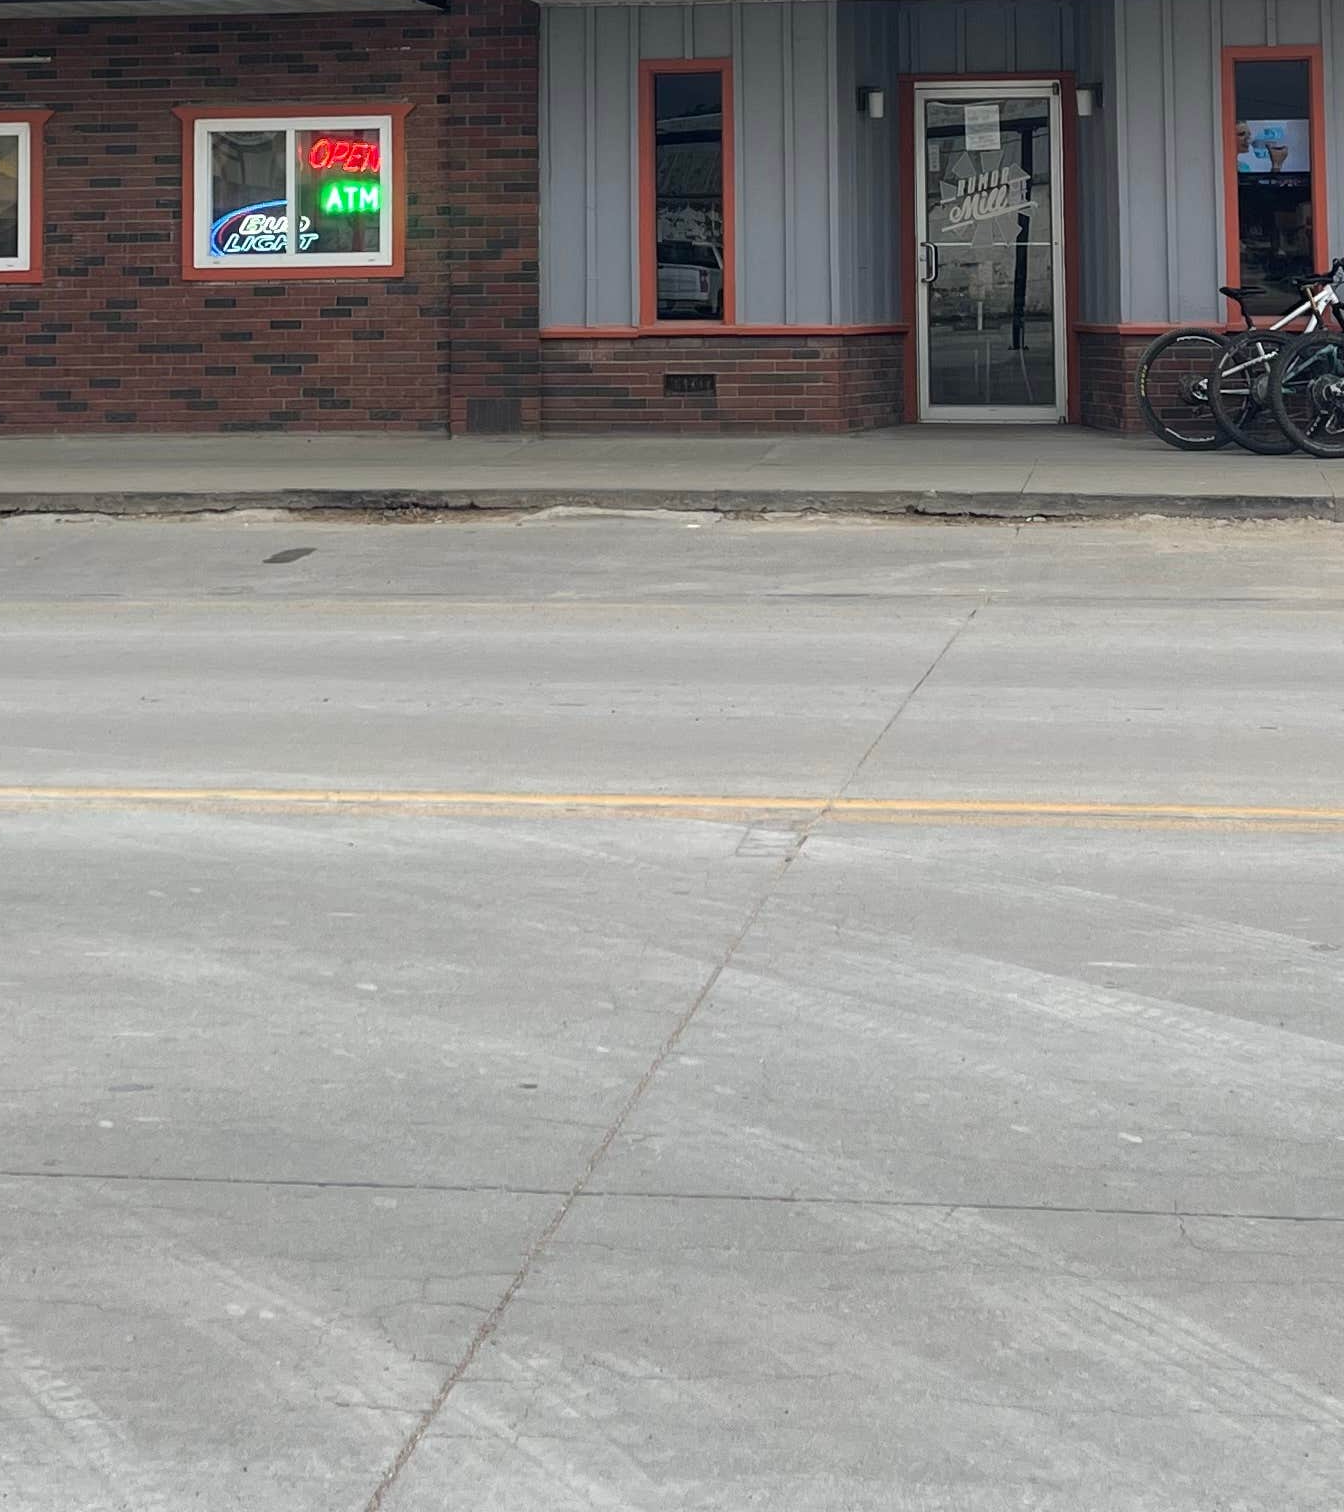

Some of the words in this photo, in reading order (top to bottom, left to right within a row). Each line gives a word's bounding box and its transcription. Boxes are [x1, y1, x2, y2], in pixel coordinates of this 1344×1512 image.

[309, 138, 382, 172] OPEN
[957, 166, 1010, 197] RUMOR
[325, 184, 380, 213] ATM
[949, 185, 1010, 223] Mill
[239, 213, 311, 235] BUD
[223, 233, 319, 253] LIGHT
